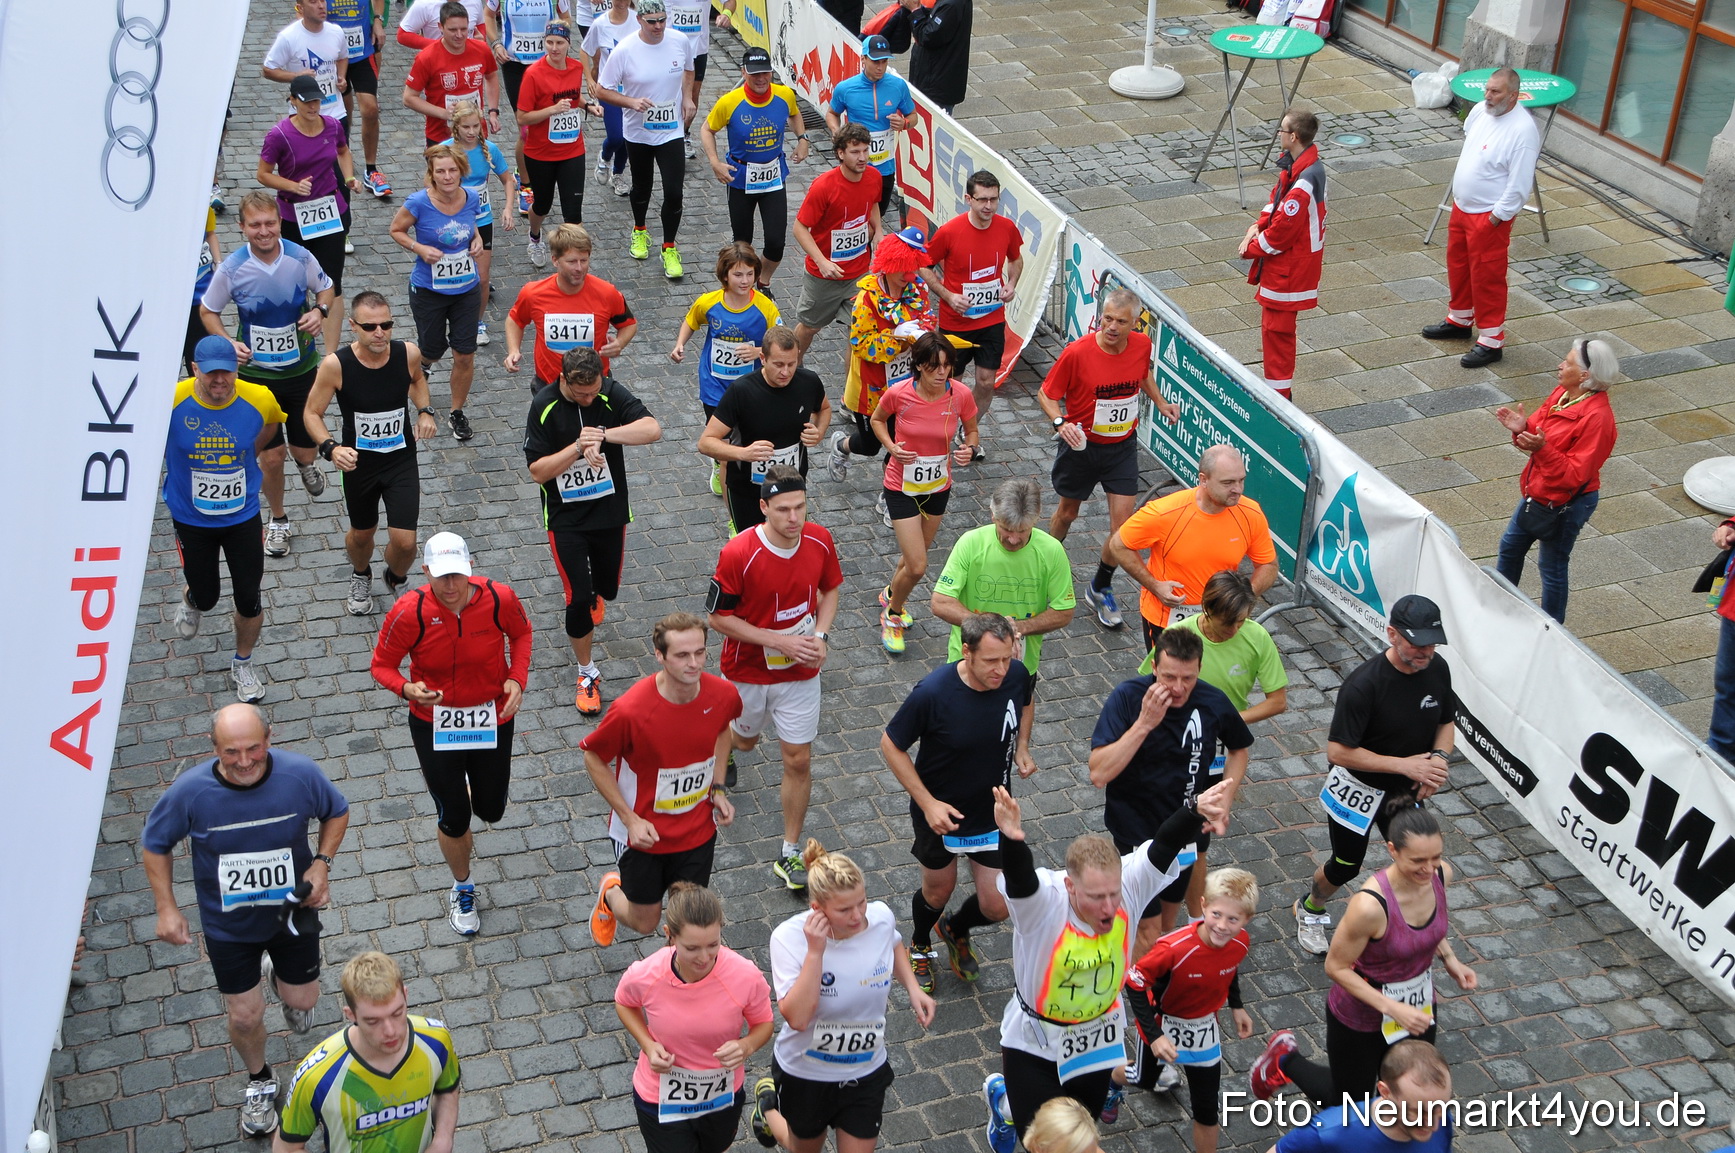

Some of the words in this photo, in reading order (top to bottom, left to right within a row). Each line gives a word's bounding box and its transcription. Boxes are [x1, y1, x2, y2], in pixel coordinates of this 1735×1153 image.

[673, 13, 701, 25] 2644
[516, 40, 544, 52] 2914
[553, 116, 578, 130] 2393
[647, 108, 675, 122] 2401
[750, 167, 779, 182] 3402
[301, 205, 334, 225] 2761
[836, 232, 866, 251] 2350
[437, 259, 471, 277] 2124
[968, 289, 999, 306] 2294
[550, 325, 589, 340] 3417
[256, 334, 295, 352] 2125
[1160, 376, 1190, 416] Mehr
[1182, 355, 1250, 422] Event-Leit-Systeme
[81, 295, 143, 502] BKK
[1109, 408, 1128, 423] 30
[361, 419, 400, 438] 2440
[1176, 419, 1193, 447] Ihr
[1154, 437, 1172, 461] Miet
[1171, 453, 1178, 467] &
[1179, 460, 1200, 487] Servic
[562, 467, 605, 489] 2842
[914, 464, 941, 482] 618
[198, 481, 242, 500] 2246
[578, 488, 597, 497] David
[1310, 569, 1338, 599] Gebäude
[1339, 590, 1363, 617] Service
[1365, 613, 1386, 634] GmbH
[49, 546, 122, 772] Audi
[440, 710, 491, 729] 2812
[448, 733, 483, 742] Clemens
[1474, 730, 1524, 787] verbinden
[671, 772, 705, 796] 109
[673, 796, 698, 809] Martin
[1328, 775, 1375, 813] 2468
[1331, 802, 1351, 820] Frank
[958, 836, 989, 846] Thomas
[221, 860, 244, 868] PARTL
[246, 856, 280, 865] Neumarkt
[227, 864, 287, 891] 2400
[1556, 804, 1707, 953] stadtwerke
[1058, 961, 1115, 1001] 40
[841, 1023, 873, 1031] Neumarkt
[1169, 1022, 1215, 1049] 3371
[817, 1032, 876, 1053] 2168
[1063, 1023, 1116, 1059] 3370
[688, 1072, 723, 1081] Neumarkt
[668, 1077, 728, 1101] 2574
[357, 1097, 430, 1131] BOCK
